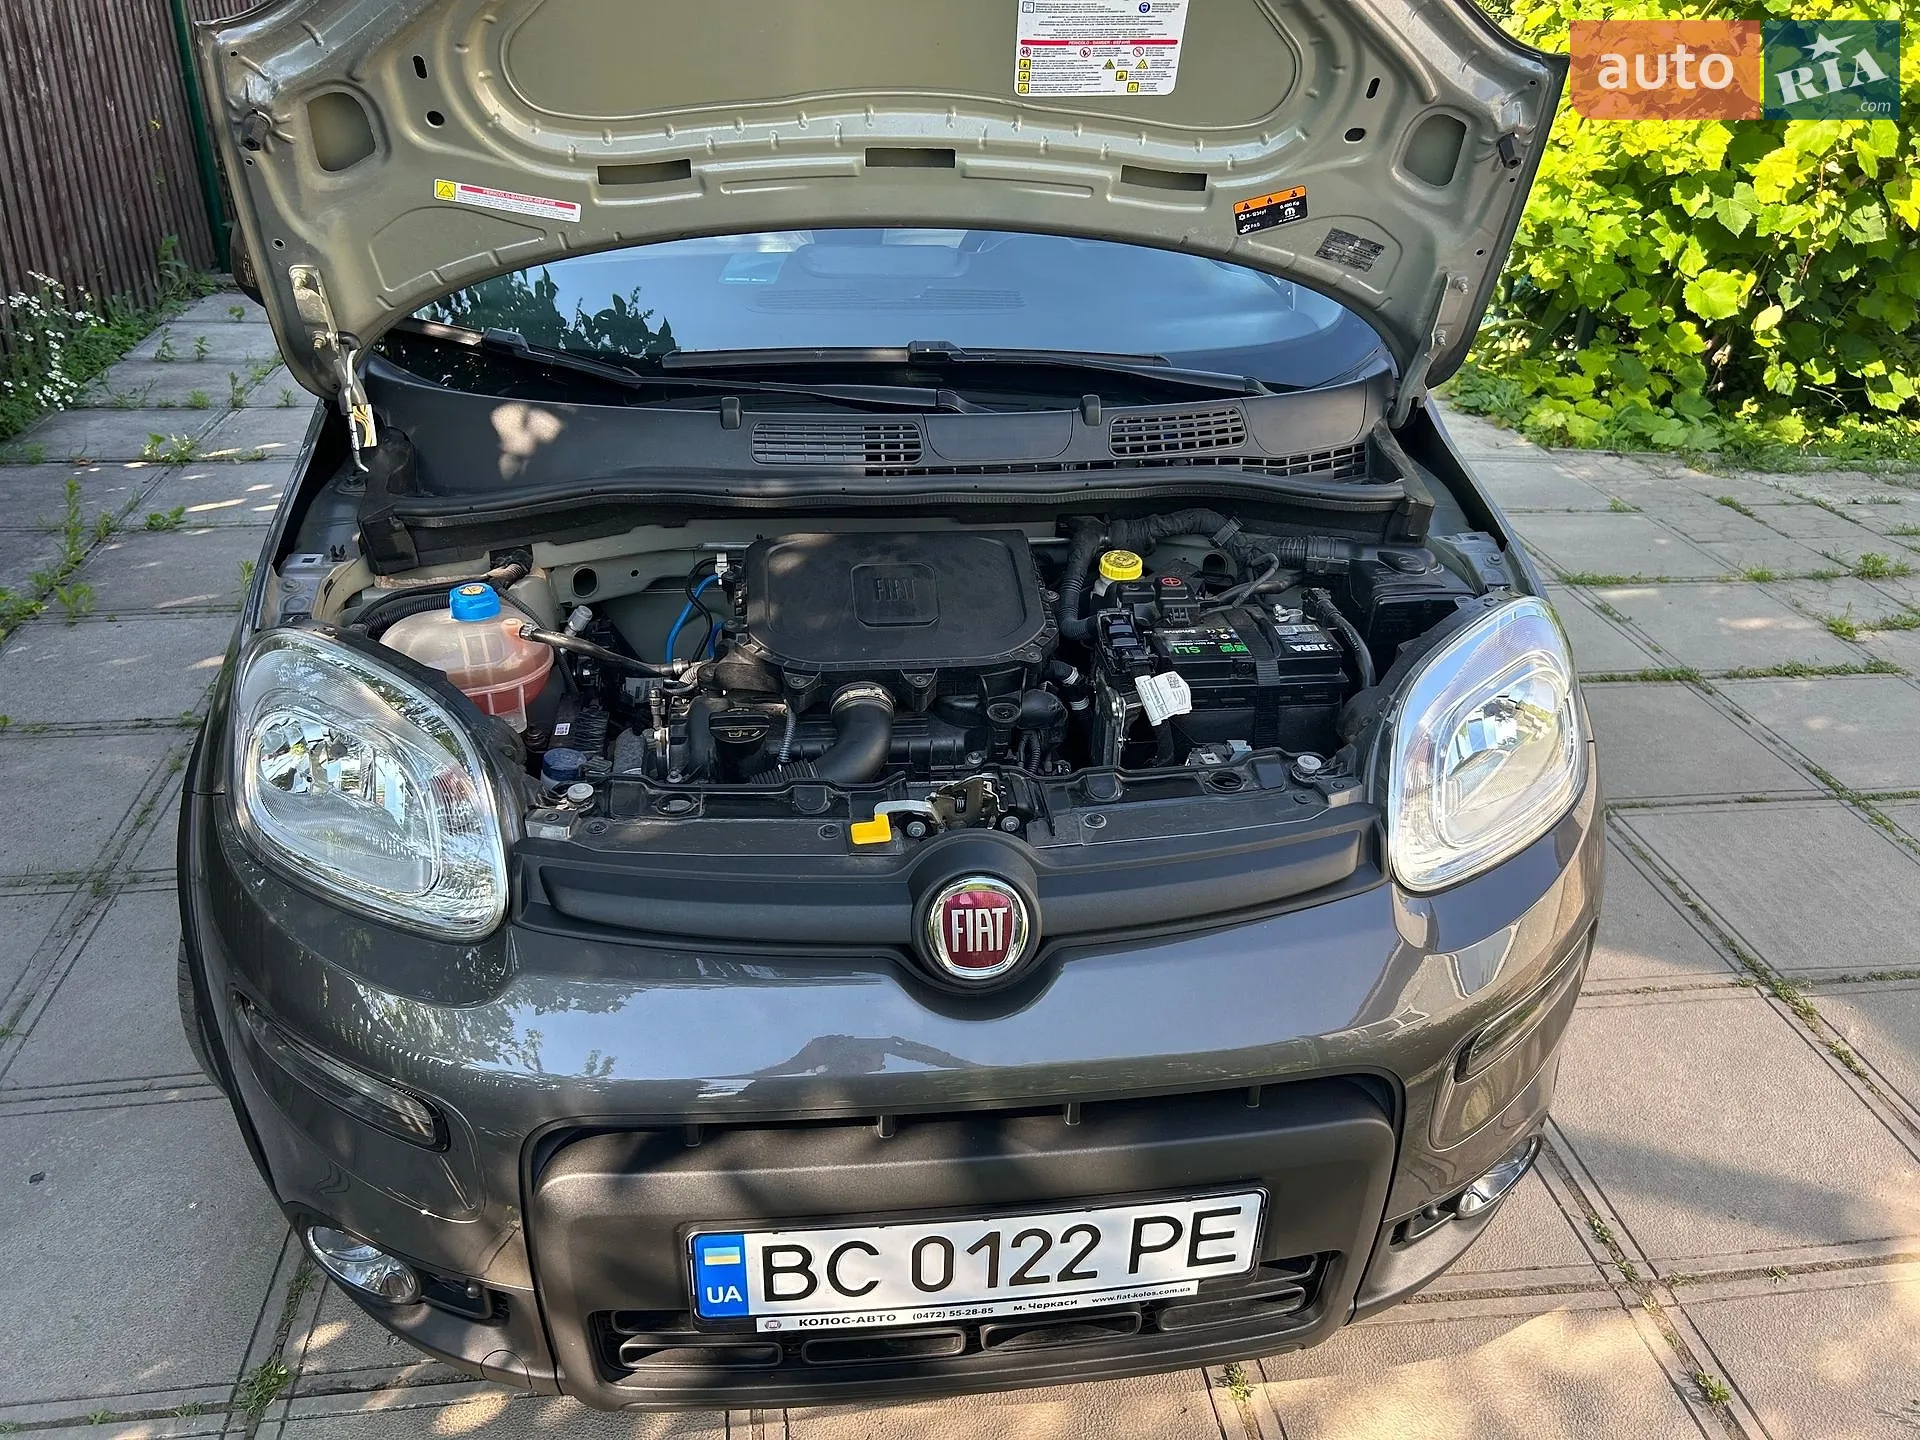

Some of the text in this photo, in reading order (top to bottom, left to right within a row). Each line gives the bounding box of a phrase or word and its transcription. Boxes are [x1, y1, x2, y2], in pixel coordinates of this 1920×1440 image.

[874, 578, 915, 601] FIAT
[951, 907, 1008, 953] FIAT
[762, 1206, 1242, 1302] BC 0122 PE
[707, 1286, 742, 1304] UA
[799, 1313, 897, 1327] КОЛОС-АВТО
[912, 1310, 946, 1320] (0472)
[949, 1306, 994, 1317] 55-28-85
[1029, 1299, 1078, 1310] Черкаси
[1091, 1287, 1191, 1304] www.fiat-kolos.com.ua
